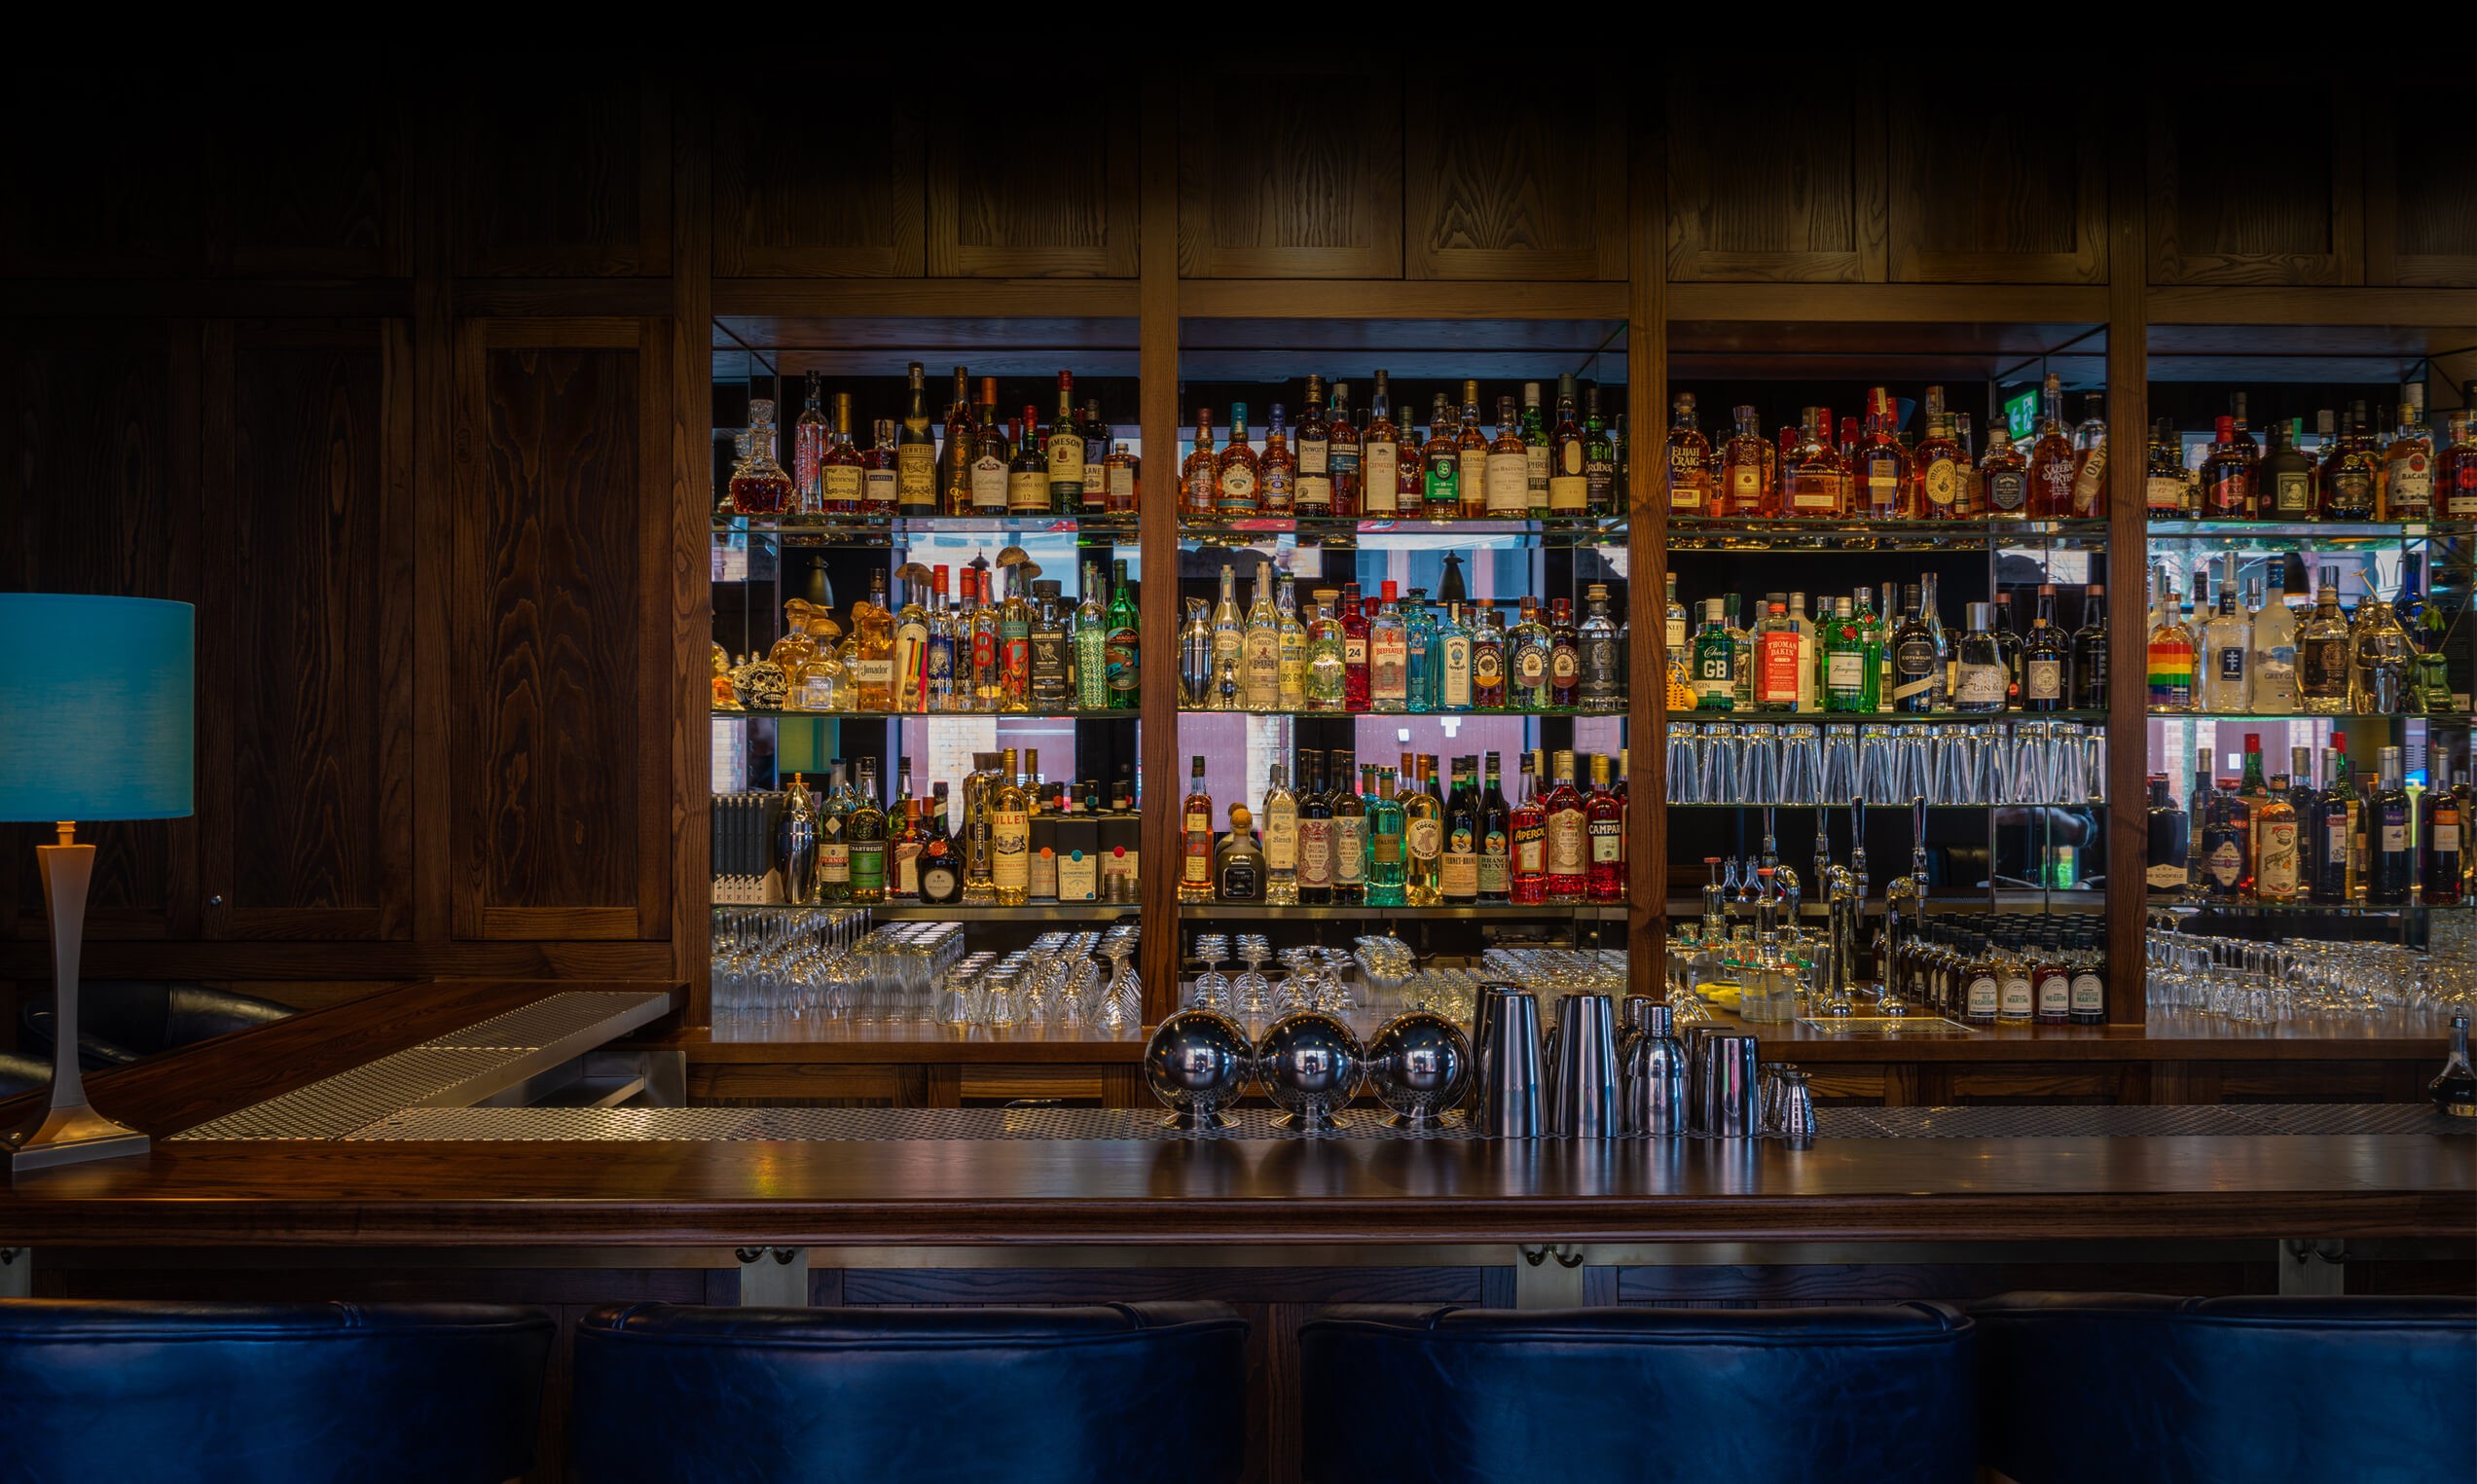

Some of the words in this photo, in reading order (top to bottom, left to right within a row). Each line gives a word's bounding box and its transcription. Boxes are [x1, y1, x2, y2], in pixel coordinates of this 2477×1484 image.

[1050, 438, 1081, 449] JAMESON
[1672, 447, 1699, 456] ELIJAH
[1671, 456, 1699, 466] CRAIG
[828, 472, 856, 484] Hennessy
[862, 665, 890, 676] Jimador
[1704, 661, 1728, 678] GB
[1515, 827, 1546, 842] APEROL
